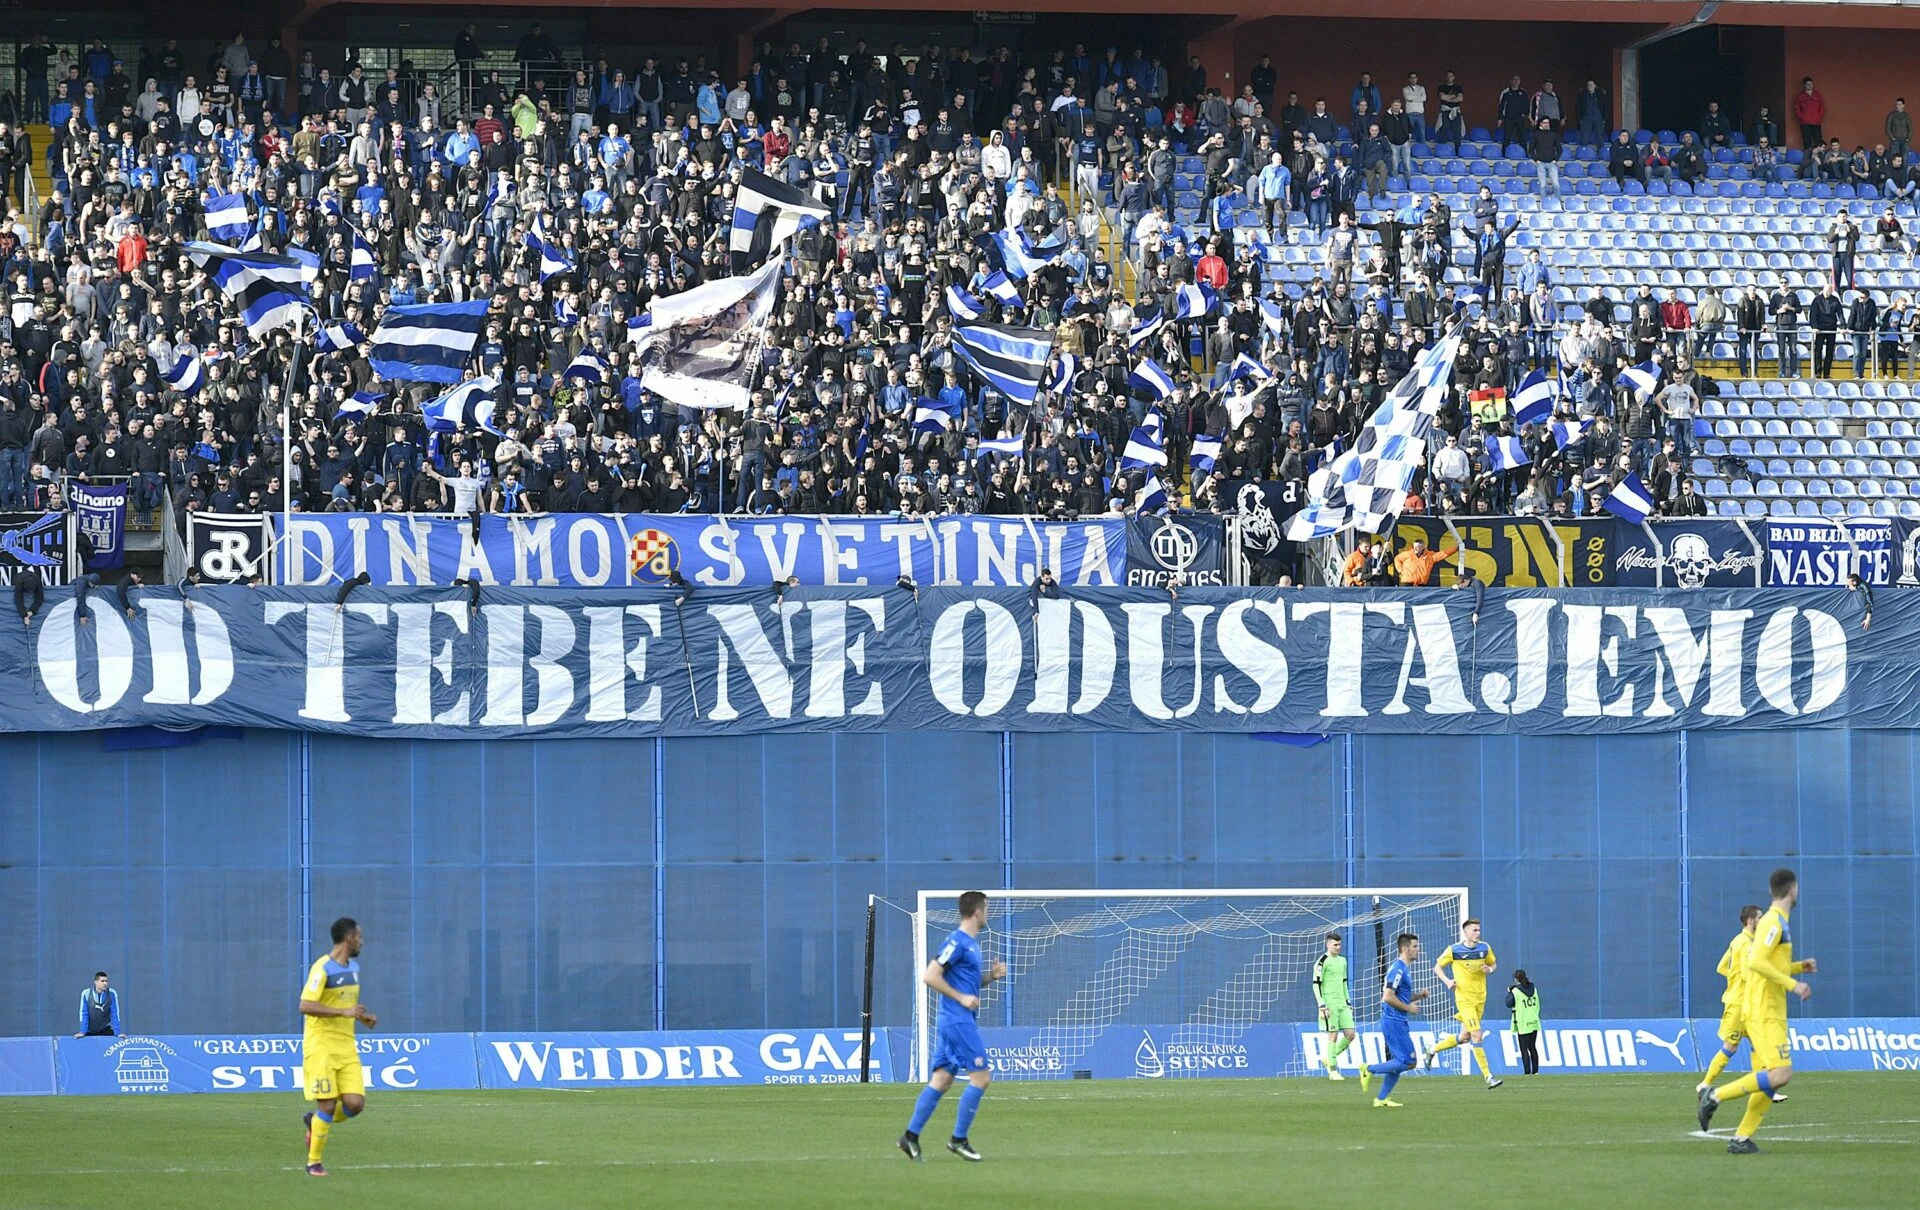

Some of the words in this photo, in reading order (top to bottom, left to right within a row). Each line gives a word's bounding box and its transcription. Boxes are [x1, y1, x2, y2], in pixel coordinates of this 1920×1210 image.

[71, 484, 125, 507] dinamo
[1770, 527, 1806, 542] BAD
[1854, 527, 1892, 542] BOYS
[289, 517, 612, 586] DINAMO
[697, 521, 1119, 587] SVETINJA
[0, 565, 62, 586] NNI
[1767, 545, 1891, 586] NAŠICE
[37, 597, 234, 713] OD
[264, 600, 662, 725] TEBE
[707, 597, 886, 721] NE
[929, 597, 1849, 719] ODUSTAJEMO
[1167, 1045, 1248, 1055] POLIKLINIKA
[1500, 1029, 1638, 1067] PUMA
[1786, 1026, 1920, 1051] habilitac
[491, 1040, 742, 1083] WEIDER
[759, 1032, 880, 1071] GAZ
[1169, 1056, 1249, 1069] SUNCE
[212, 1056, 419, 1089] STIIĆ
[987, 1058, 1062, 1072] SUNCE
[121, 1084, 169, 1092] STIPIĆ
[764, 1074, 804, 1084] SPORT
[808, 1075, 817, 1084] &
[821, 1074, 882, 1084] ZDRAVJE
